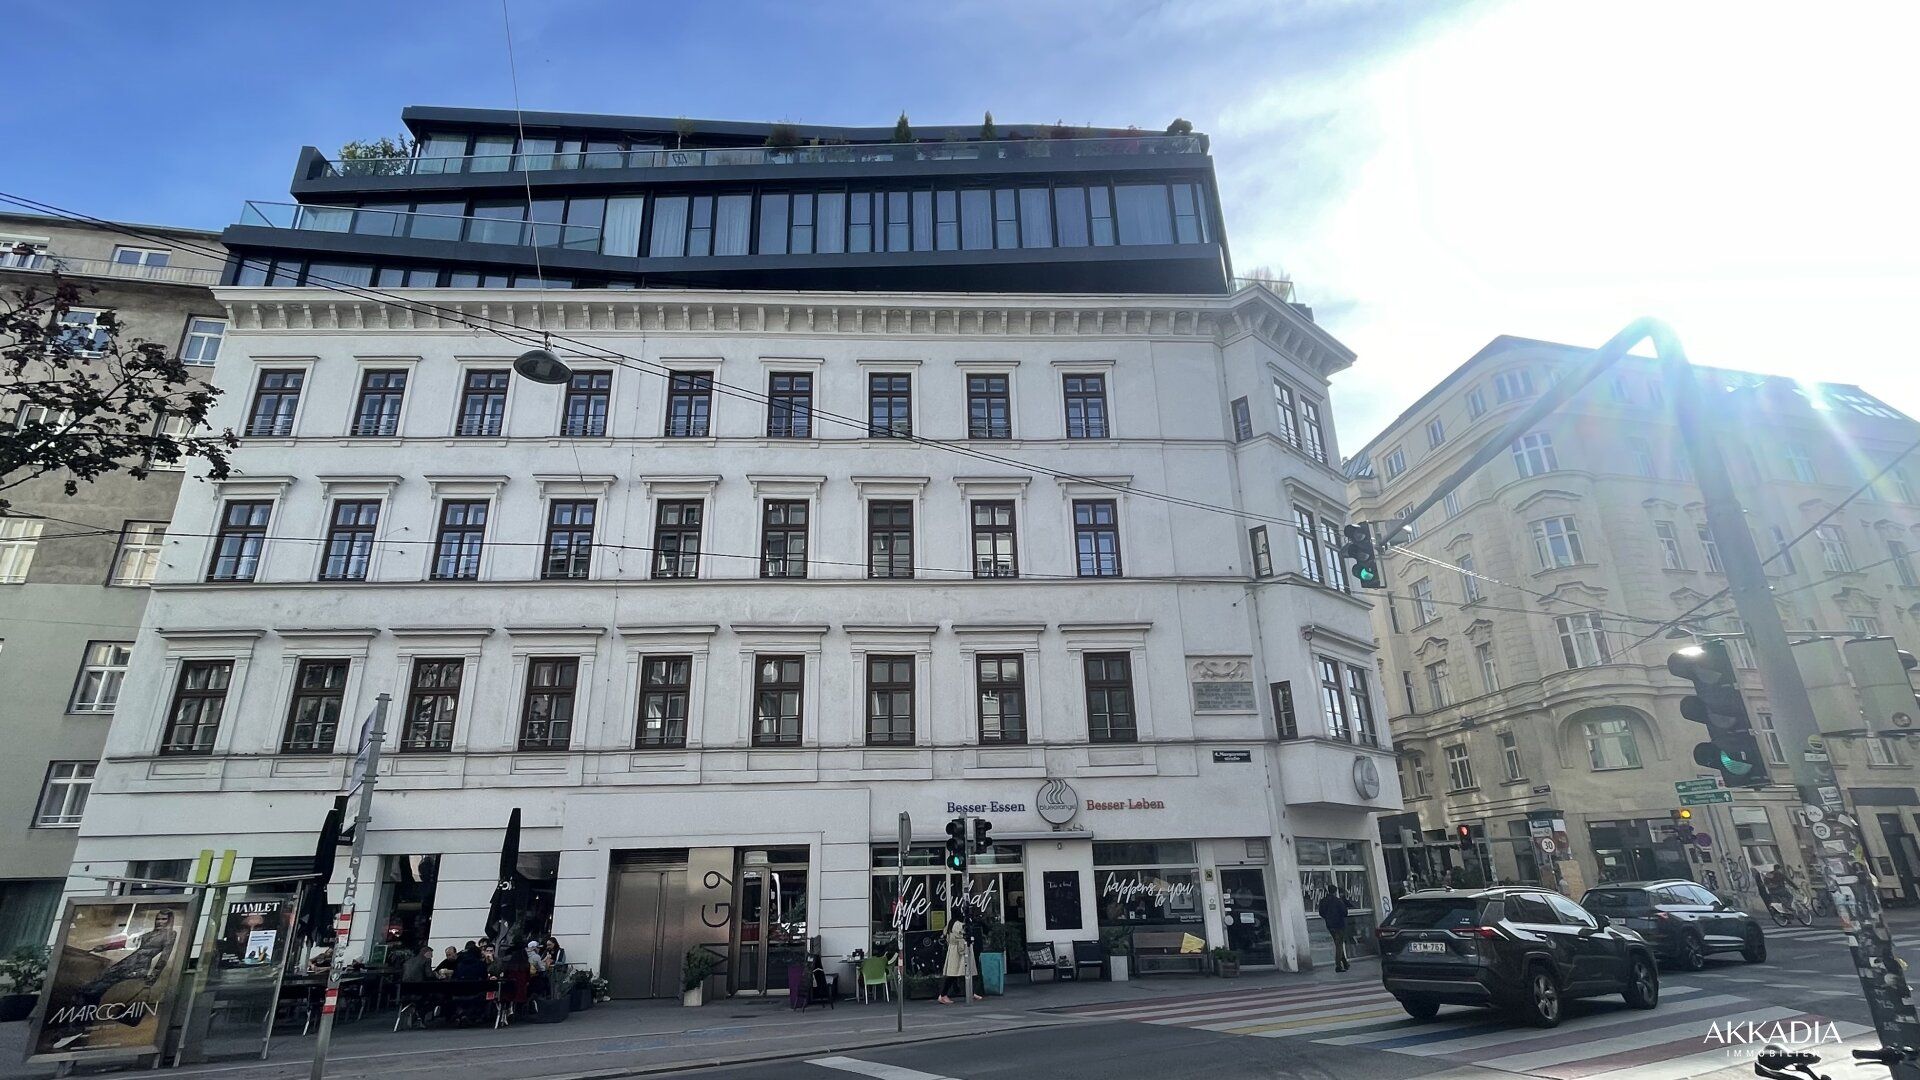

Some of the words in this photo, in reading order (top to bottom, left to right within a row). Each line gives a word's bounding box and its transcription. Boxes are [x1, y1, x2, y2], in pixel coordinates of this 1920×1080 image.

[946, 801, 988, 813] Besser
[989, 801, 1026, 813] Essen
[1086, 799, 1125, 811] Besser
[1127, 797, 1165, 810] Leben
[1543, 840, 1554, 851] 30
[1102, 871, 1156, 904] happens
[1167, 882, 1195, 904] you
[230, 902, 280, 914] HAMLET
[892, 875, 932, 931] life
